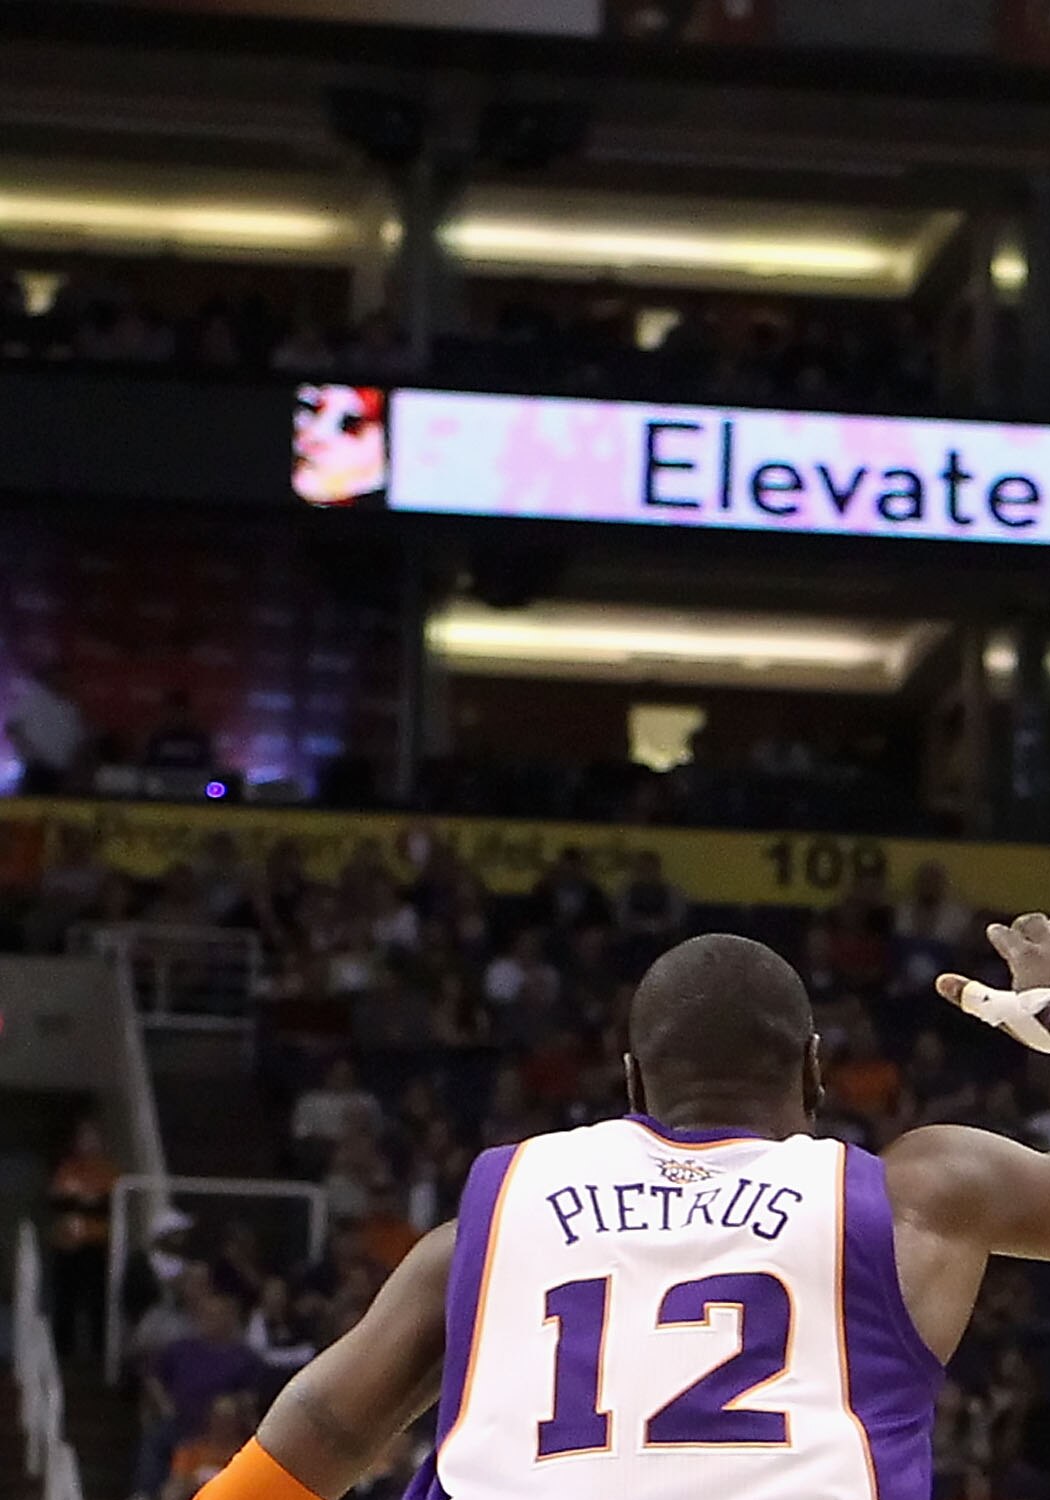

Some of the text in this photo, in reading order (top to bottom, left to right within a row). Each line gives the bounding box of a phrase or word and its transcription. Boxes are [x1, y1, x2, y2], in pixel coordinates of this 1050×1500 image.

[643, 419, 1041, 528] Elevate
[546, 1178, 803, 1246] PIETRUS
[534, 1269, 796, 1463] 12
